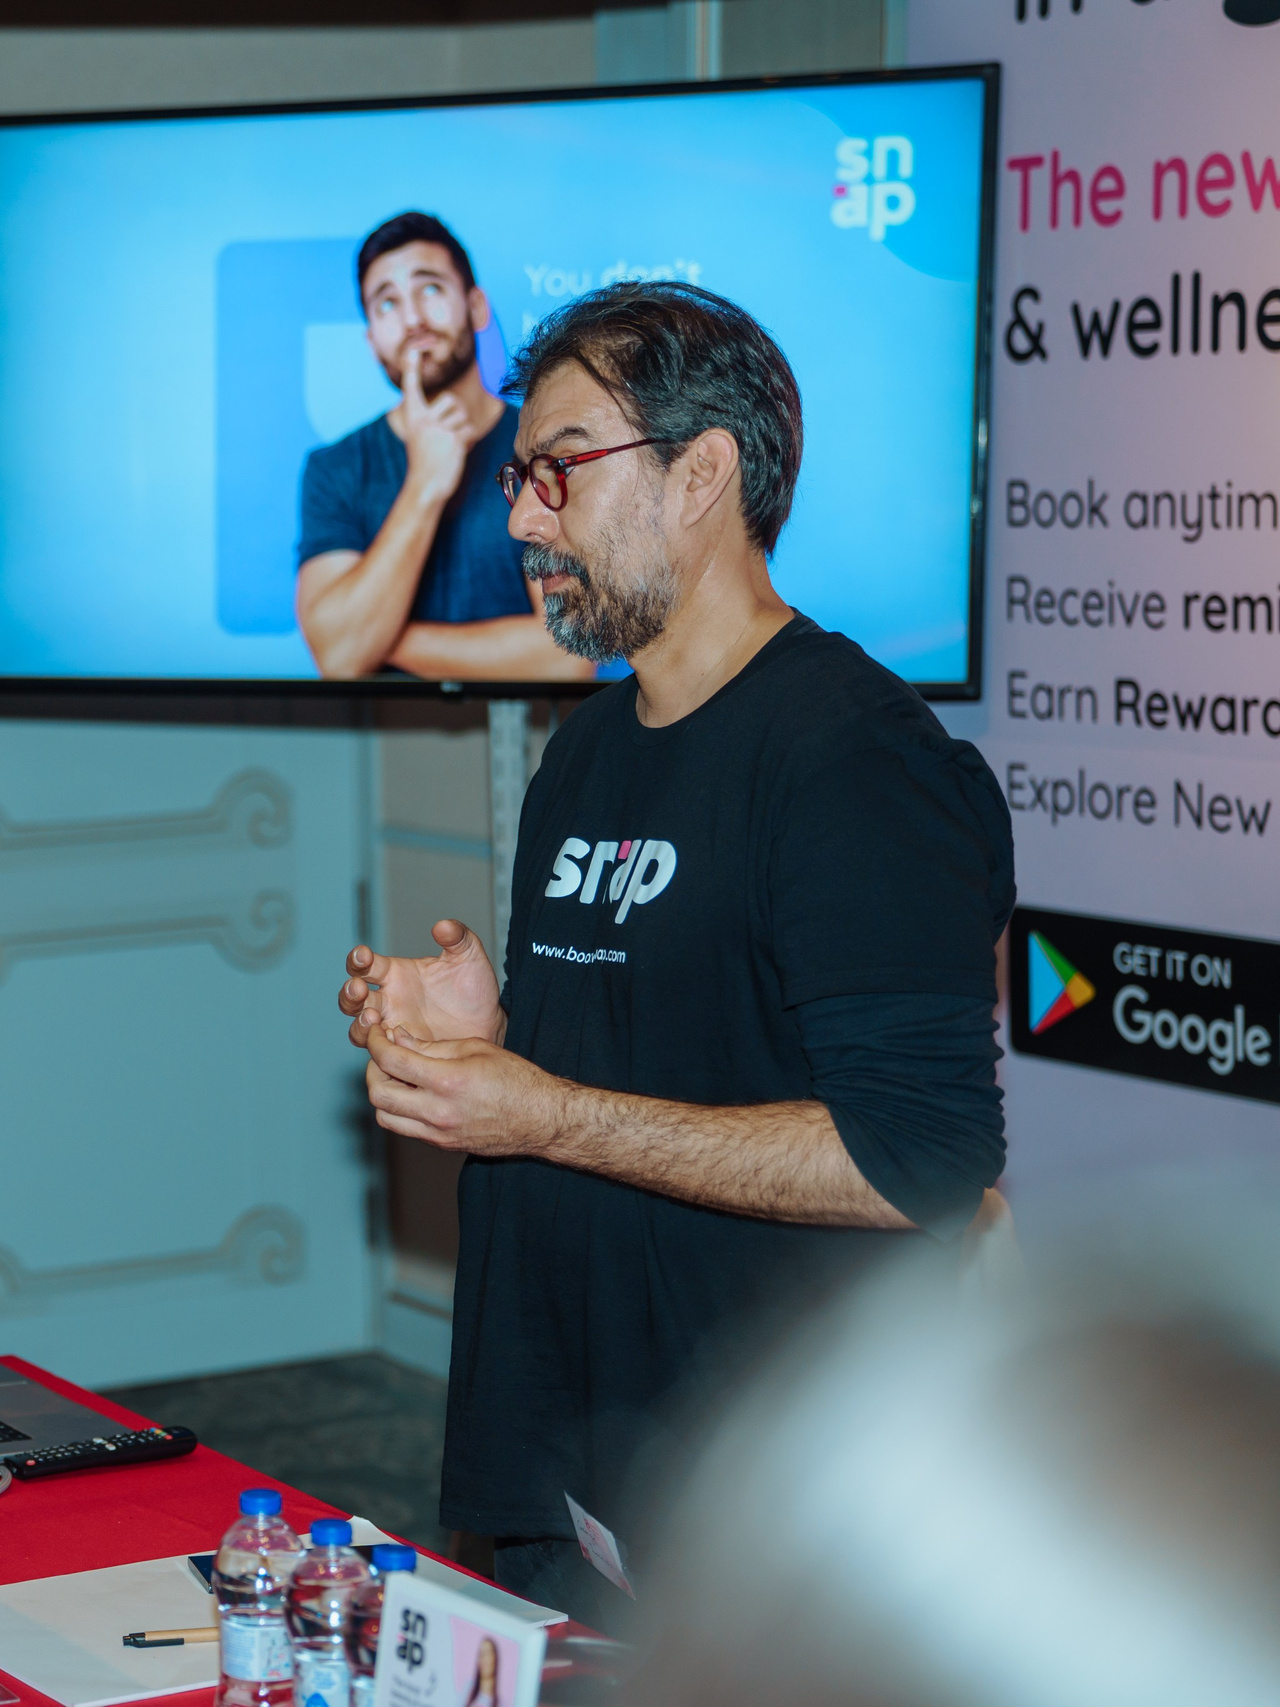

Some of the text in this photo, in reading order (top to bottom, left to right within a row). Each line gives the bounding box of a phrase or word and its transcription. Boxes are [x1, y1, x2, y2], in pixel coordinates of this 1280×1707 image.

[1006, 149, 1280, 233] The new
[524, 262, 592, 297] You
[1005, 285, 1048, 364] &
[1007, 478, 1279, 543] Book anytim
[1007, 575, 1167, 630] Receive
[1007, 670, 1098, 722] Earn
[1007, 762, 1271, 837] Explore New
[1113, 942, 1232, 989] GET IT ON
[1113, 984, 1271, 1076] Google
